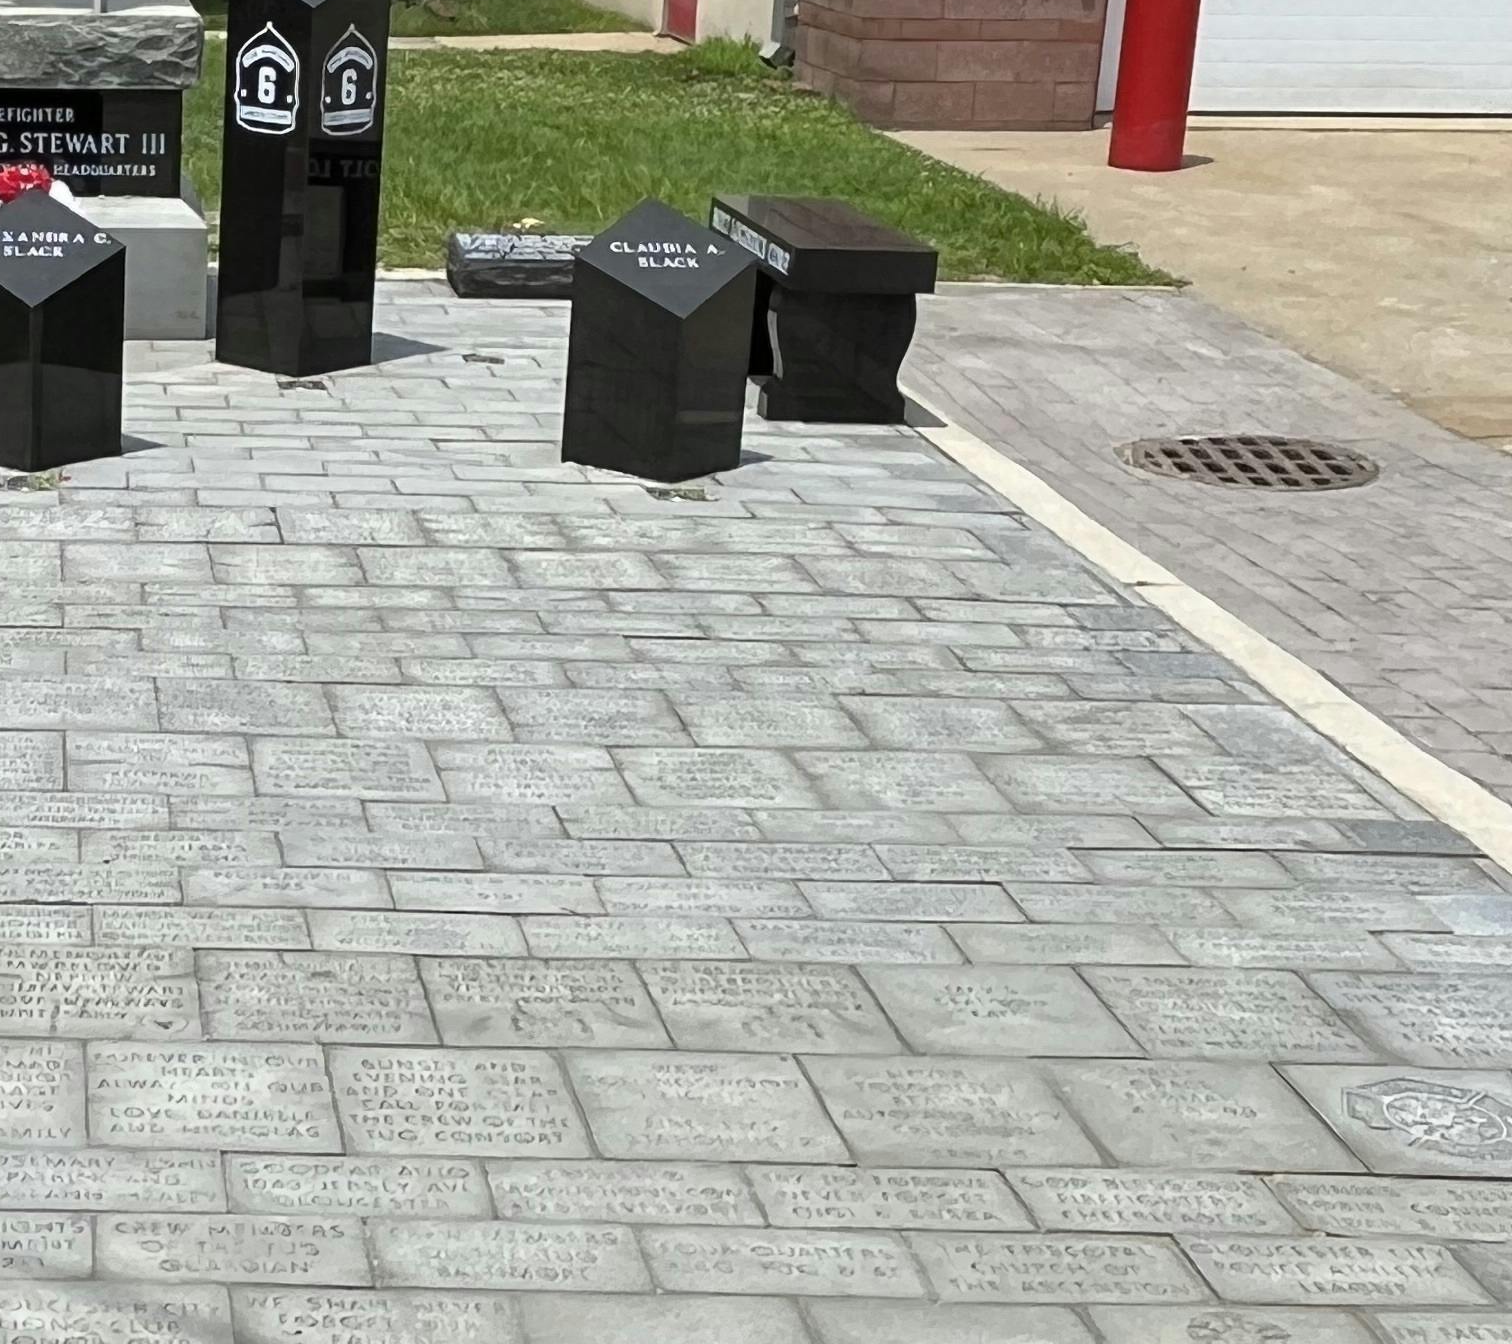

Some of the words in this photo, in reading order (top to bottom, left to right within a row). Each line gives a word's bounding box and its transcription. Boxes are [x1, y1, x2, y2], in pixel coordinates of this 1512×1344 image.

[257, 66, 277, 104] 6
[341, 68, 358, 105] 6
[19, 131, 130, 155] STEWART
[141, 132, 166, 155] III
[53, 164, 156, 177] HEADQUARTERS
[609, 241, 697, 254] CLAUDIA
